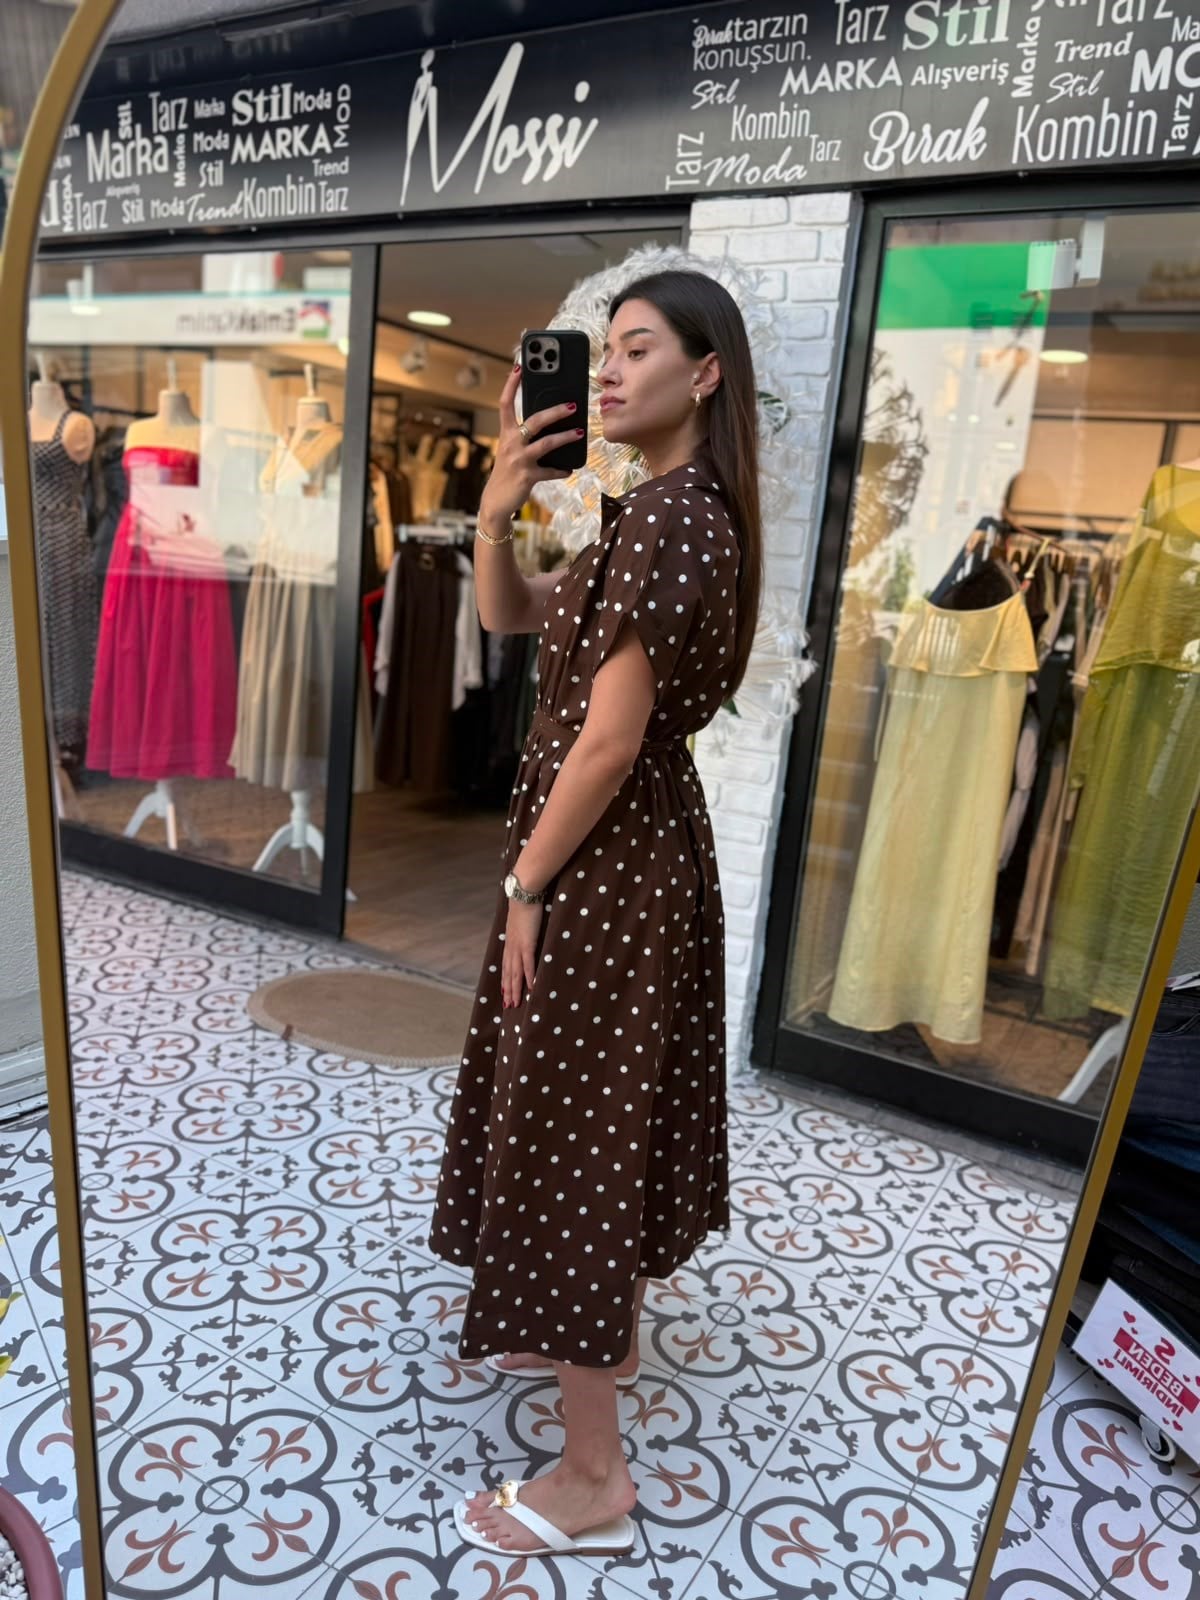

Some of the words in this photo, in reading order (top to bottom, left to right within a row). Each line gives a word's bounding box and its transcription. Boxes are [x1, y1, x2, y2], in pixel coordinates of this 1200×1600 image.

[734, 13, 808, 43] tarzın
[835, 0, 890, 45] Tarz
[903, 0, 1010, 51] Stil
[693, 40, 812, 73] konuşsun.
[1011, 16, 1041, 98] Marka
[1054, 32, 1134, 64] Trend
[690, 78, 740, 110] Stil
[778, 56, 903, 97] MARKA
[910, 58, 1010, 90] Alışveriş
[1045, 69, 1104, 104] Stil
[148, 91, 188, 134] Tarz
[194, 98, 226, 119] Marka
[231, 83, 293, 126] Stil
[292, 88, 333, 114] Moda
[333, 83, 350, 148] MOD
[730, 101, 811, 142] Kombin
[193, 129, 229, 154] Moda
[230, 122, 333, 165] MARKA
[401, 42, 599, 207] Mossi
[863, 96, 989, 172] Bırak
[1011, 97, 1158, 164] Kombin
[1162, 92, 1194, 159] Tarz
[86, 122, 170, 184] Marka
[173, 133, 187, 188] Marka
[312, 156, 350, 177] Trend
[665, 131, 705, 192] Tarz
[702, 145, 808, 188] Moda
[809, 134, 842, 163] Tarz
[199, 160, 224, 188] Stil
[73, 192, 109, 232] Tarz
[121, 198, 145, 225] Stil
[150, 199, 186, 220] Moda
[185, 191, 244, 223] Trend
[242, 174, 317, 220] Kombin
[318, 181, 350, 213] Tarz
